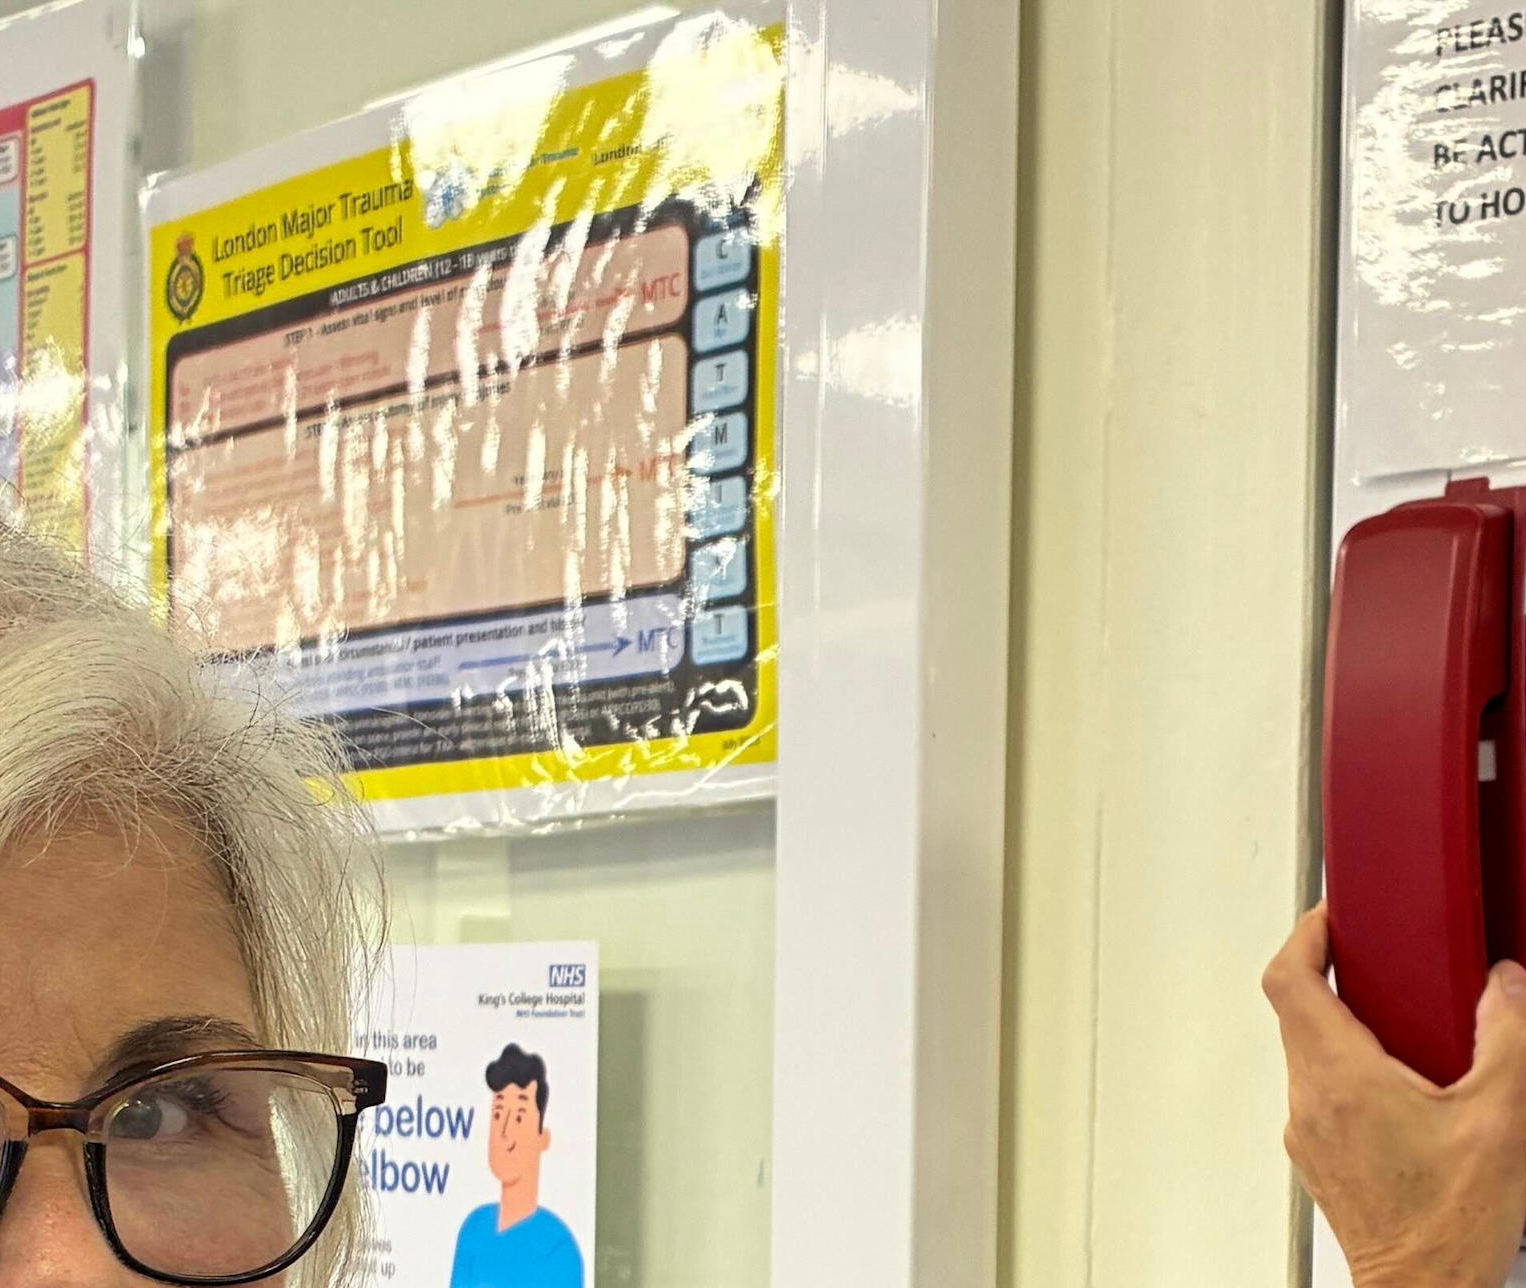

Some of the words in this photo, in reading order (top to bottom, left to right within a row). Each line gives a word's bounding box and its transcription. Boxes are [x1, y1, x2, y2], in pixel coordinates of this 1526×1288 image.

[1434, 138, 1468, 170] BE
[212, 223, 277, 262] London
[280, 203, 336, 240] Major
[339, 179, 415, 221] Trauma
[223, 262, 274, 297] Triage
[281, 239, 357, 281] Decision
[360, 216, 404, 252] Tool
[330, 284, 371, 305] ADULTS
[381, 264, 433, 291] CHILDREN
[641, 272, 681, 304] MTC
[713, 303, 728, 325] A
[715, 363, 727, 382] T
[714, 423, 728, 445] M
[550, 965, 585, 986] NHS
[508, 991, 544, 1008] College
[546, 991, 585, 1007] Hospital
[372, 1031, 399, 1049] this
[403, 1035, 437, 1050] area
[389, 1059, 403, 1076] to
[406, 1058, 425, 1077] be
[374, 1093, 475, 1141] below
[380, 1261, 396, 1280] up
